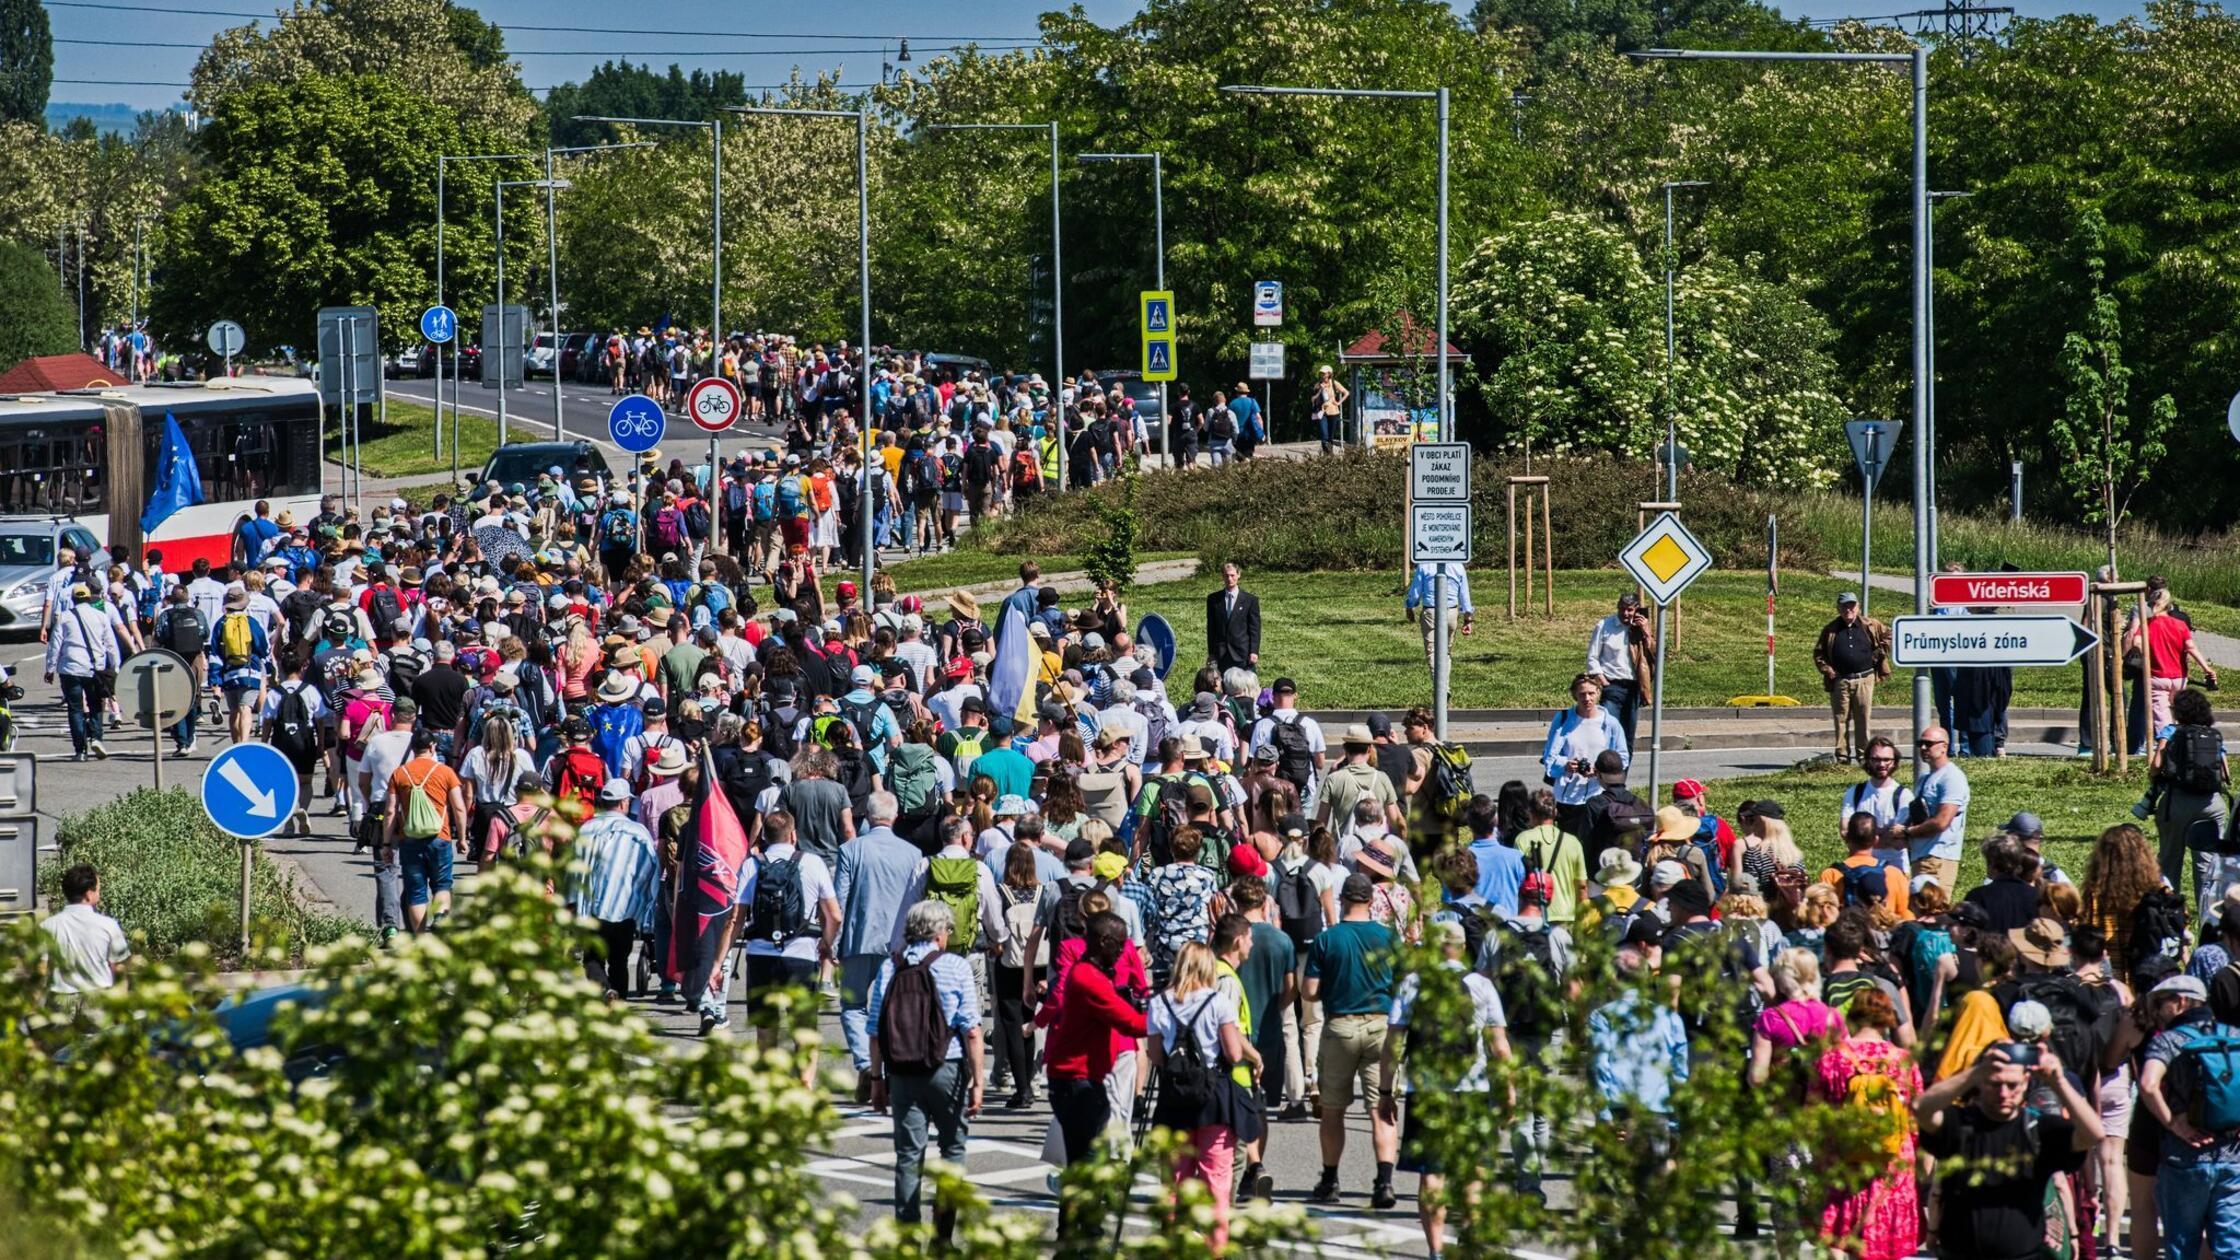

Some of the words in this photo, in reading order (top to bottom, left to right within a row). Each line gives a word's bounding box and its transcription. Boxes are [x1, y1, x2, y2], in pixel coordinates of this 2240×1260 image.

[1420, 451, 1425, 459] V
[1426, 451, 1442, 459] OBCI
[1443, 449, 1461, 459] PLATÍ
[1431, 461, 1451, 471] ZÁKAZ
[1422, 473, 1461, 483] PODOMNÍHO
[1427, 486, 1456, 495] PRODEJE
[1968, 580, 2050, 599] Vídeňská
[1904, 632, 1987, 653] Průmyslová
[1994, 632, 2028, 649] zóna
